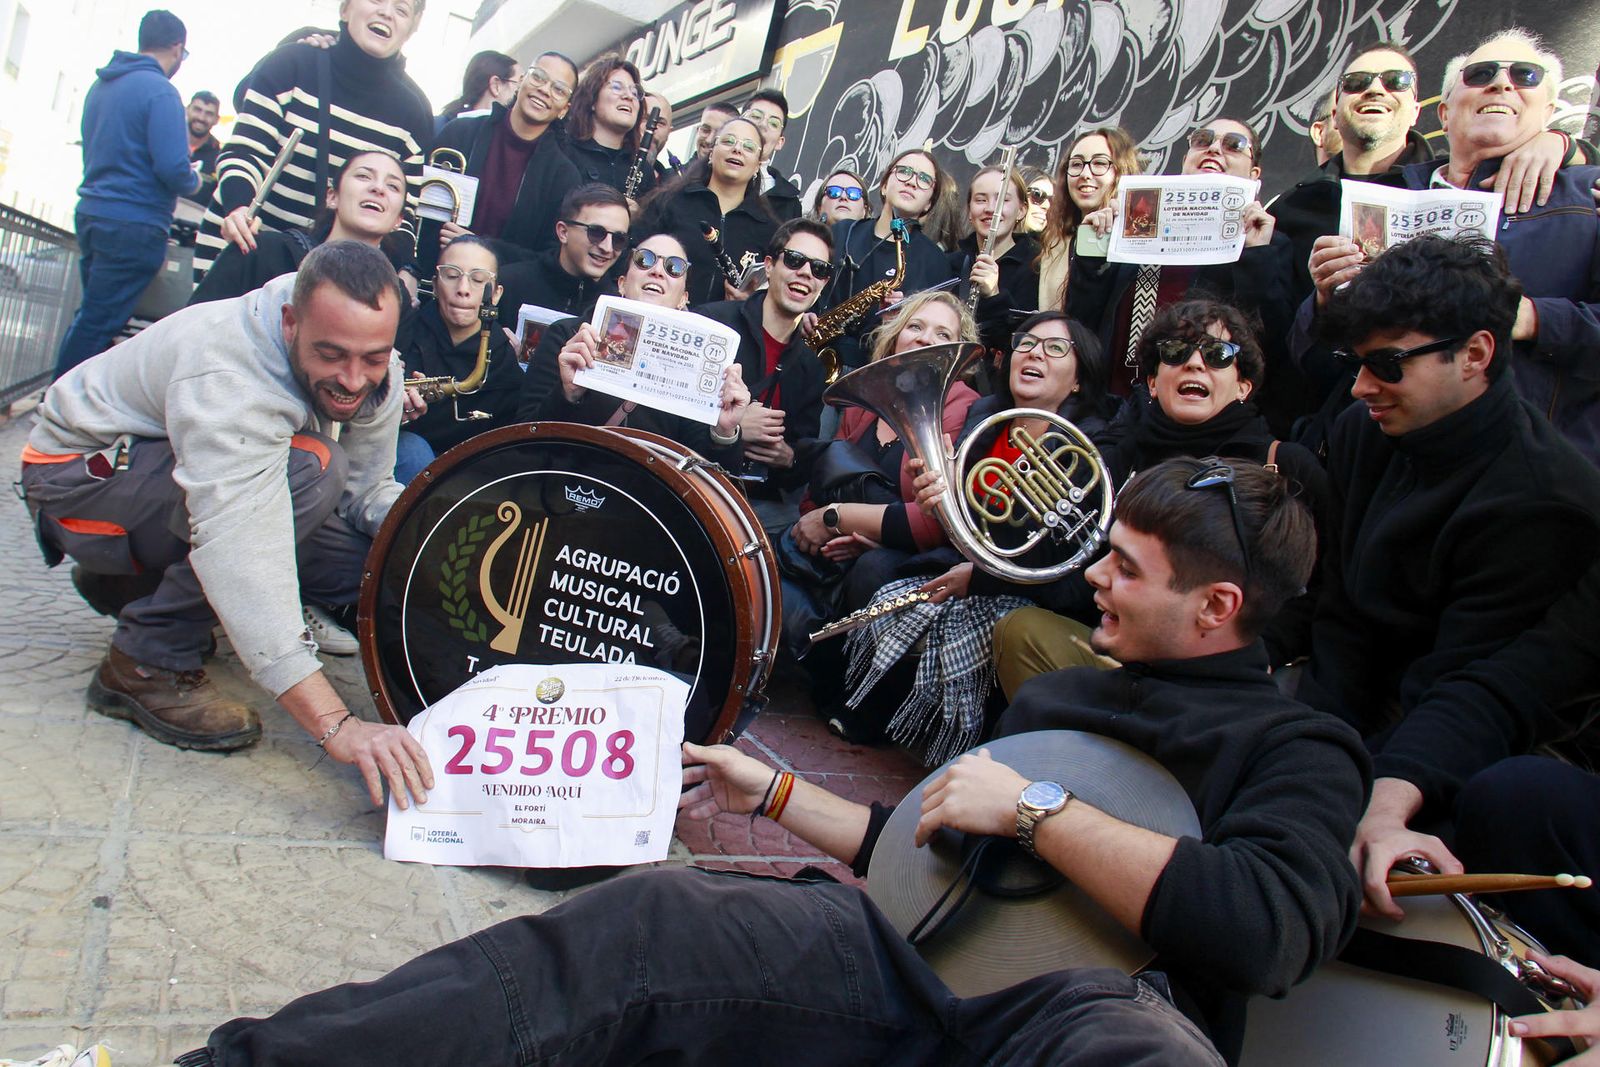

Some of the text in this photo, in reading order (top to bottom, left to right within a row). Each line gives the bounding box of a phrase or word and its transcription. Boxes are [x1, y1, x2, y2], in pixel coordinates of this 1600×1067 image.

[1164, 191, 1221, 203] 25508
[1391, 208, 1453, 228] 25508
[645, 323, 704, 347] 25508
[643, 339, 700, 359] LOTERÍA NACIONAL
[660, 349, 689, 361] NAVIDAD
[703, 378, 713, 388] 20
[569, 493, 598, 506] REMO
[555, 545, 680, 595] AGRUPACIÓ
[549, 570, 645, 616] MUSICAL
[543, 598, 654, 648] CULTURAL
[539, 624, 636, 665] TEULADA
[509, 706, 606, 725] PREMIO
[444, 725, 635, 780] 25508
[482, 784, 582, 800] VENDIDO AQUÍ
